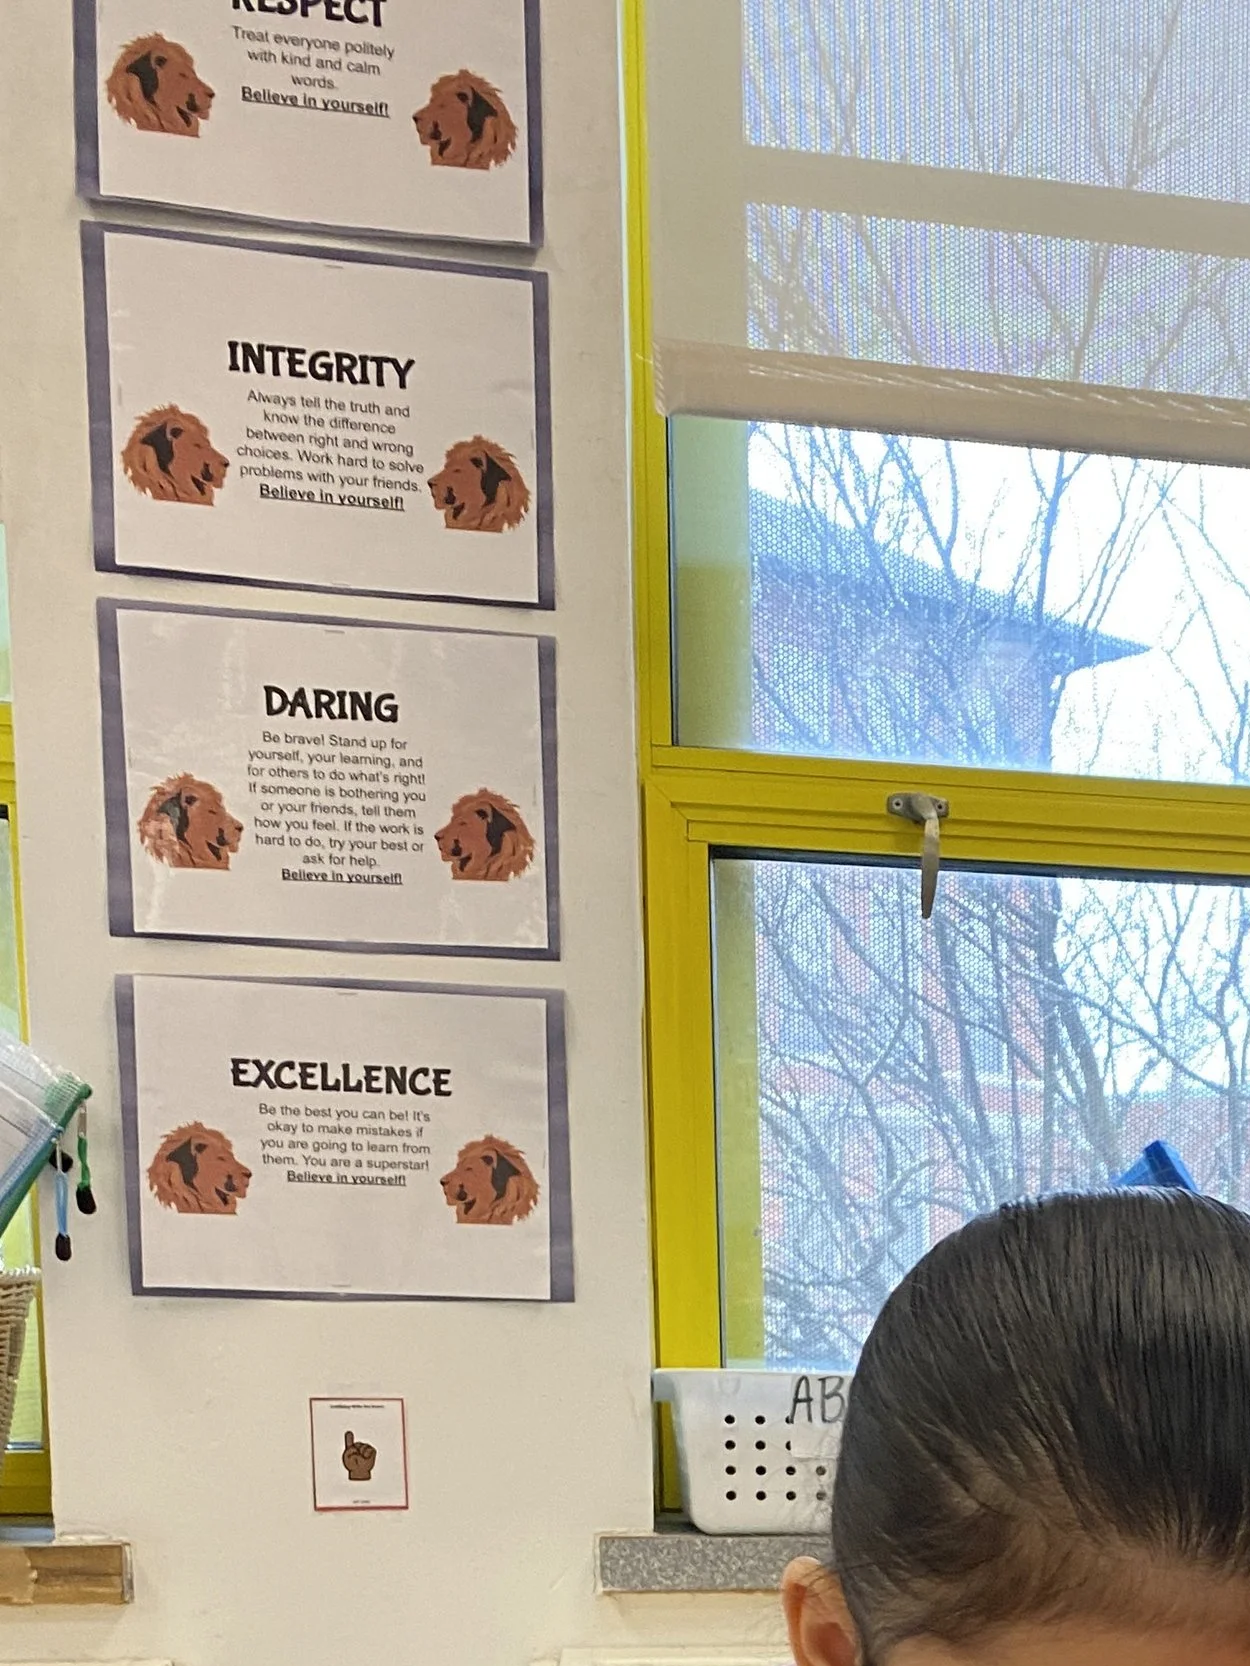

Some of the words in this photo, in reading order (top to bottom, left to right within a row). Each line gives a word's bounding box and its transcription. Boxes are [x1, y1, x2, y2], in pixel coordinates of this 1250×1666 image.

[232, 25, 268, 41] Treat
[274, 33, 340, 50] everyone
[345, 41, 394, 61] politely
[248, 49, 276, 63] with
[282, 51, 311, 68] kind
[316, 58, 342, 70] and
[347, 60, 380, 75] calm
[292, 74, 337, 89] words.
[242, 86, 298, 106] Believe
[304, 92, 316, 108] in
[322, 100, 389, 117] yourself!
[228, 341, 415, 389] INTEGRITY
[248, 389, 296, 408] Always
[301, 396, 320, 408] tell
[325, 398, 346, 411] the
[350, 401, 380, 414] truth
[385, 405, 410, 418] and
[263, 410, 298, 424] know
[304, 414, 325, 427] the
[330, 417, 396, 434] difference
[247, 427, 304, 443] between
[309, 435, 338, 448] right
[343, 437, 368, 450] and
[372, 444, 413, 457] wrong
[237, 446, 292, 460] choices.
[297, 449, 333, 464] Work
[338, 454, 368, 469] hard
[373, 458, 384, 469] to
[389, 460, 424, 473] solve
[240, 465, 302, 481] problems
[307, 472, 334, 484] with
[339, 476, 368, 487] your
[373, 477, 421, 492] friends.
[260, 484, 315, 502] Believe
[320, 489, 333, 505] in
[338, 494, 404, 512] yourself!
[264, 686, 398, 722] DARING
[263, 731, 280, 743] Be
[285, 733, 324, 745] brave!
[329, 734, 366, 748] Stand
[371, 739, 386, 751] up
[391, 738, 407, 750] for
[248, 750, 303, 763] yourself,
[308, 753, 335, 764] your
[340, 752, 395, 769] learning,
[400, 757, 423, 768] and
[247, 765, 268, 776] for
[269, 767, 308, 779] others
[313, 770, 325, 780] to
[329, 770, 345, 780] do
[350, 771, 389, 782] what's
[394, 774, 425, 786] right!
[249, 783, 257, 793] If
[261, 785, 320, 796] someone
[325, 786, 335, 796] is
[340, 786, 398, 803] bothering
[403, 792, 426, 803] you
[261, 802, 272, 811] or
[278, 803, 307, 814] your
[311, 803, 357, 817] friends,
[362, 806, 380, 817] tell
[384, 807, 416, 818] them
[254, 817, 280, 828] how
[285, 820, 308, 831] you
[313, 820, 339, 831] feel.
[344, 820, 352, 831] If
[356, 821, 375, 832] the
[379, 824, 409, 835] work
[414, 825, 423, 835] is
[255, 834, 285, 846] hard
[289, 836, 300, 846] to
[329, 838, 345, 850] try
[350, 840, 380, 851] your
[381, 839, 407, 850] best
[412, 842, 423, 852] or
[302, 853, 325, 864] ask
[329, 854, 345, 865] for
[282, 868, 327, 881] Believe
[332, 870, 343, 883] in
[347, 873, 403, 885] yourself!
[231, 1058, 452, 1096] EXCELLENCE
[259, 1104, 276, 1115] Be
[280, 1104, 300, 1116] the
[305, 1105, 331, 1117] best
[336, 1109, 358, 1121] you
[363, 1110, 385, 1120] can
[389, 1109, 408, 1121] be!
[413, 1110, 430, 1122] It's
[267, 1122, 298, 1134] okay
[302, 1123, 314, 1133] to
[318, 1123, 352, 1134] make
[356, 1124, 412, 1137] mistakes
[417, 1126, 423, 1137] if
[260, 1140, 284, 1151] you
[288, 1140, 308, 1149] are
[312, 1141, 347, 1153] going
[351, 1141, 363, 1151] to
[367, 1141, 398, 1153] learn
[402, 1143, 430, 1154] from
[262, 1155, 298, 1166] them.
[302, 1155, 326, 1167] You
[331, 1157, 350, 1167] are
[355, 1159, 363, 1168] a
[367, 1159, 429, 1172] superstar!
[287, 1171, 332, 1184] Believe
[337, 1172, 348, 1185] in
[352, 1175, 406, 1186] yourself!
